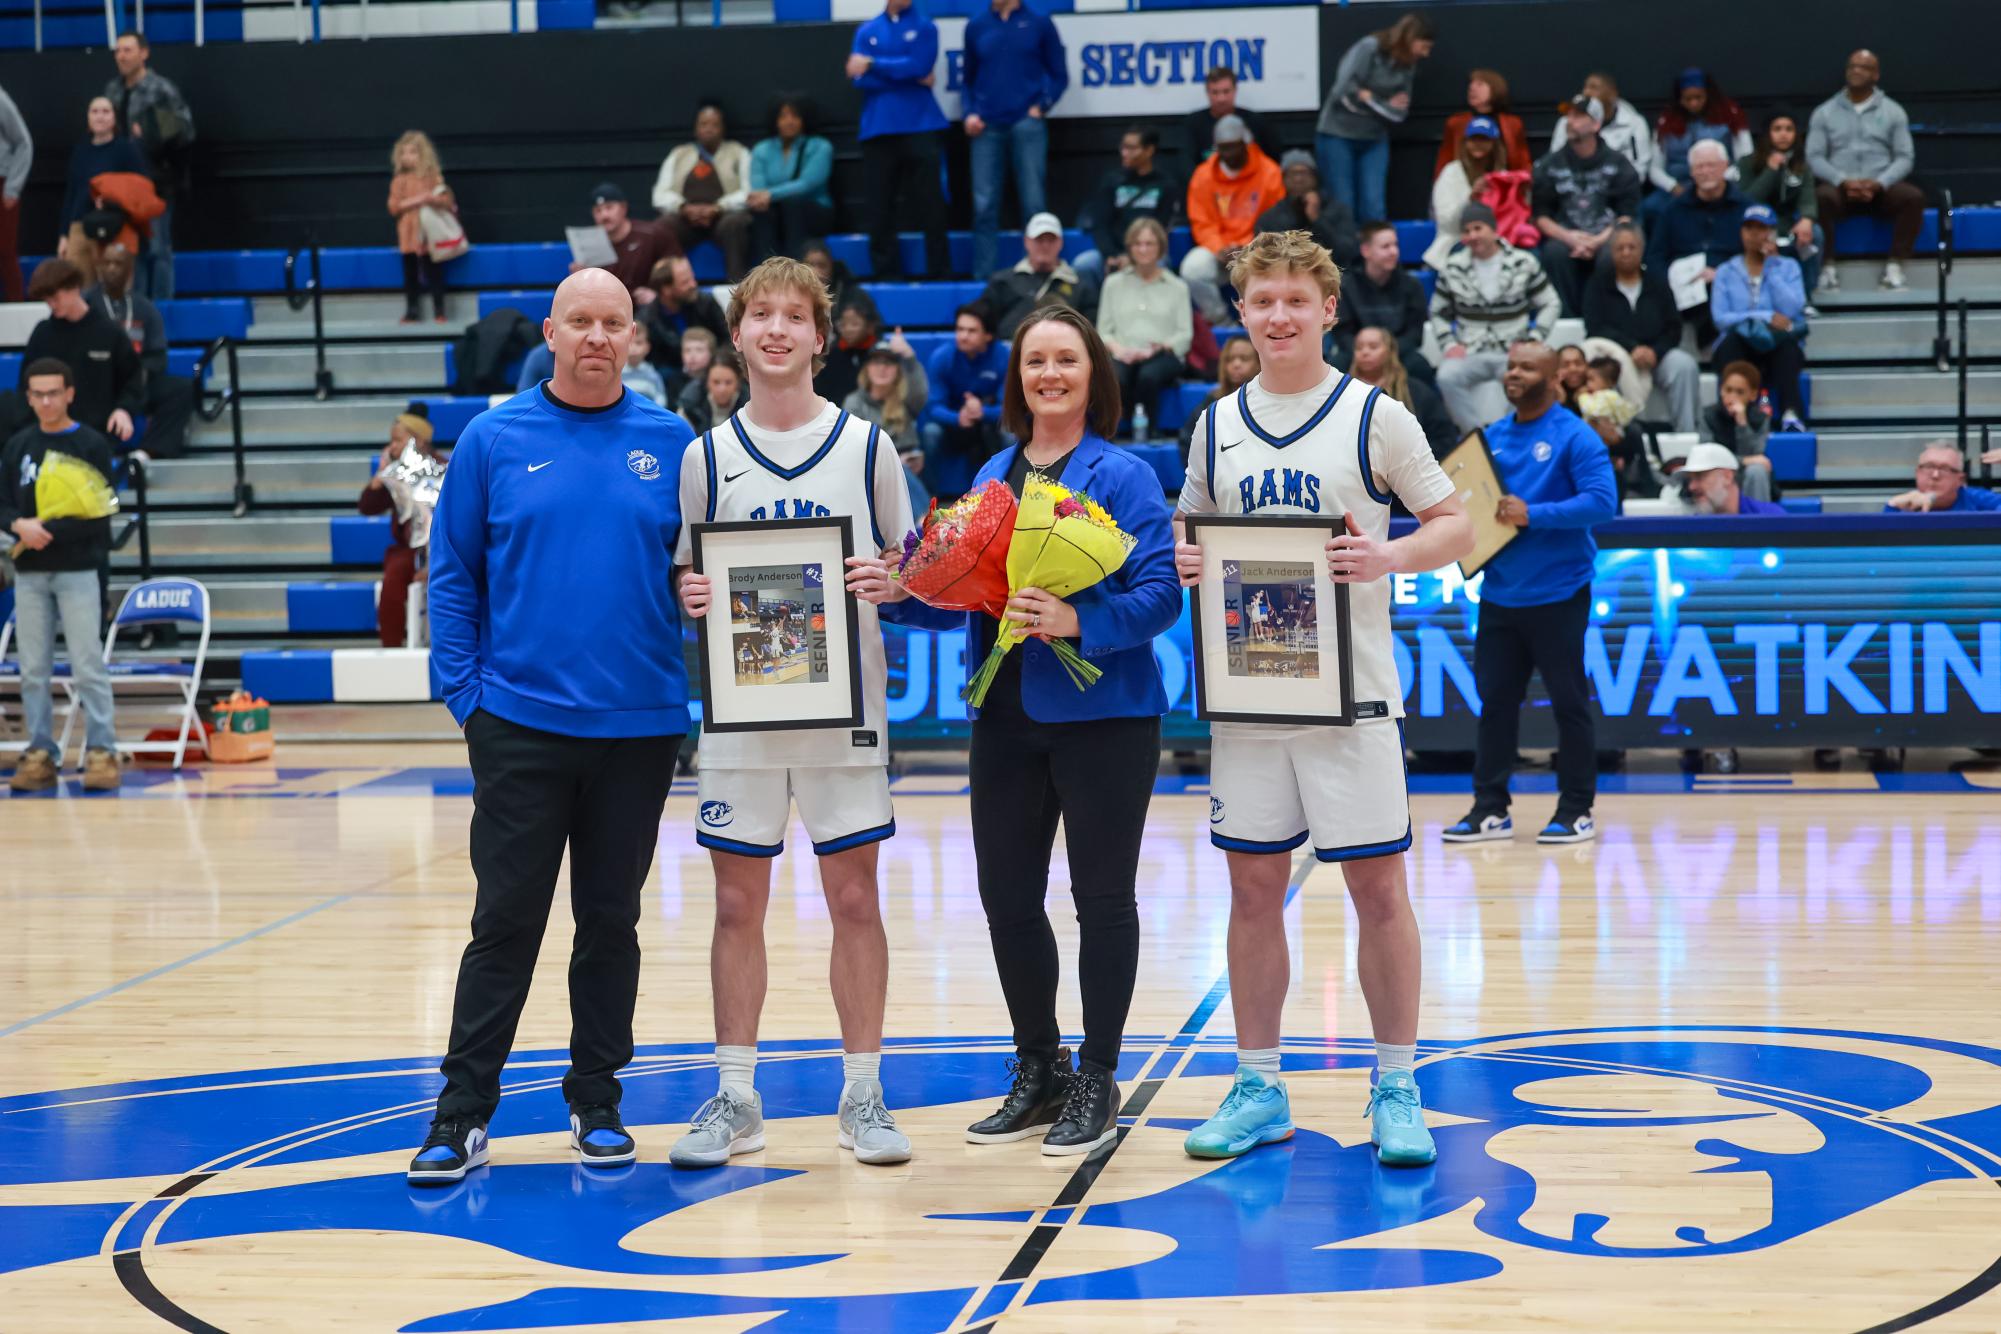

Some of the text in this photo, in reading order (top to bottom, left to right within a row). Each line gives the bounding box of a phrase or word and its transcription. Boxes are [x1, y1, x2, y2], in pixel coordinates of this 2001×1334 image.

[1081, 39, 1266, 87] SECTION
[1239, 468, 1320, 513] RAMS
[729, 572, 802, 583] Brody Anderson
[1241, 567, 1314, 577] Jack Anderson
[136, 587, 192, 609] LADUE
